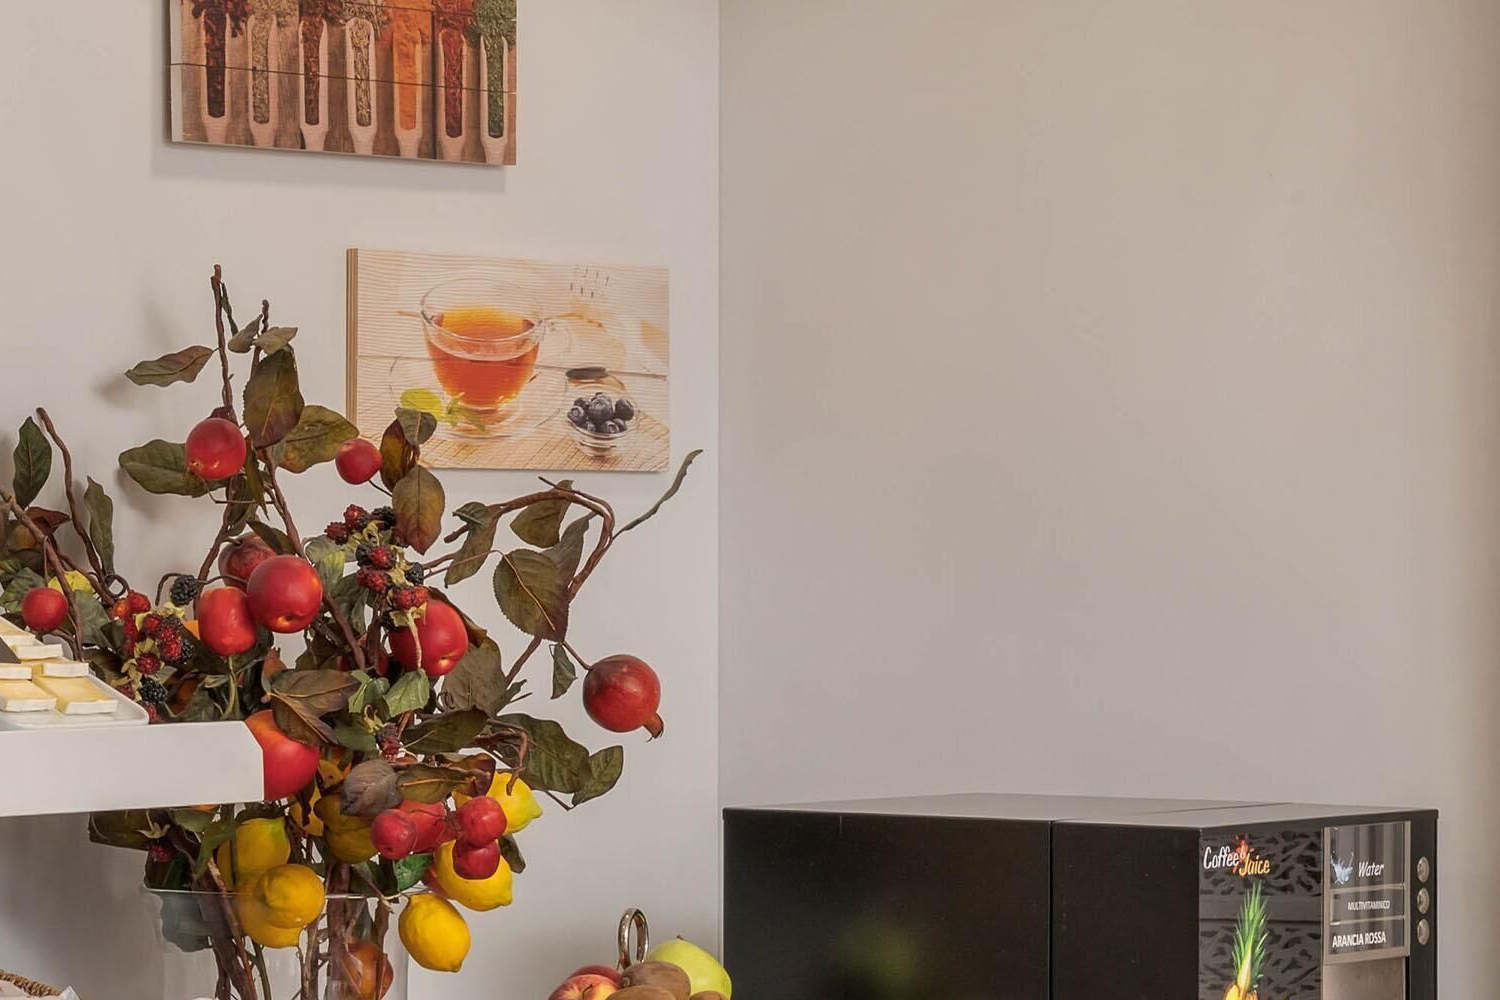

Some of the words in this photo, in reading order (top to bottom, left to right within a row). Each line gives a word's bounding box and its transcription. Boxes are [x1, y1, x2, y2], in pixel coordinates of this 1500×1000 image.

[1203, 845, 1239, 869] Coffee
[1239, 852, 1270, 876] Juice
[1358, 861, 1385, 877] Water
[1332, 933, 1364, 948] ARANCIA
[1364, 931, 1387, 945] ROSSA
